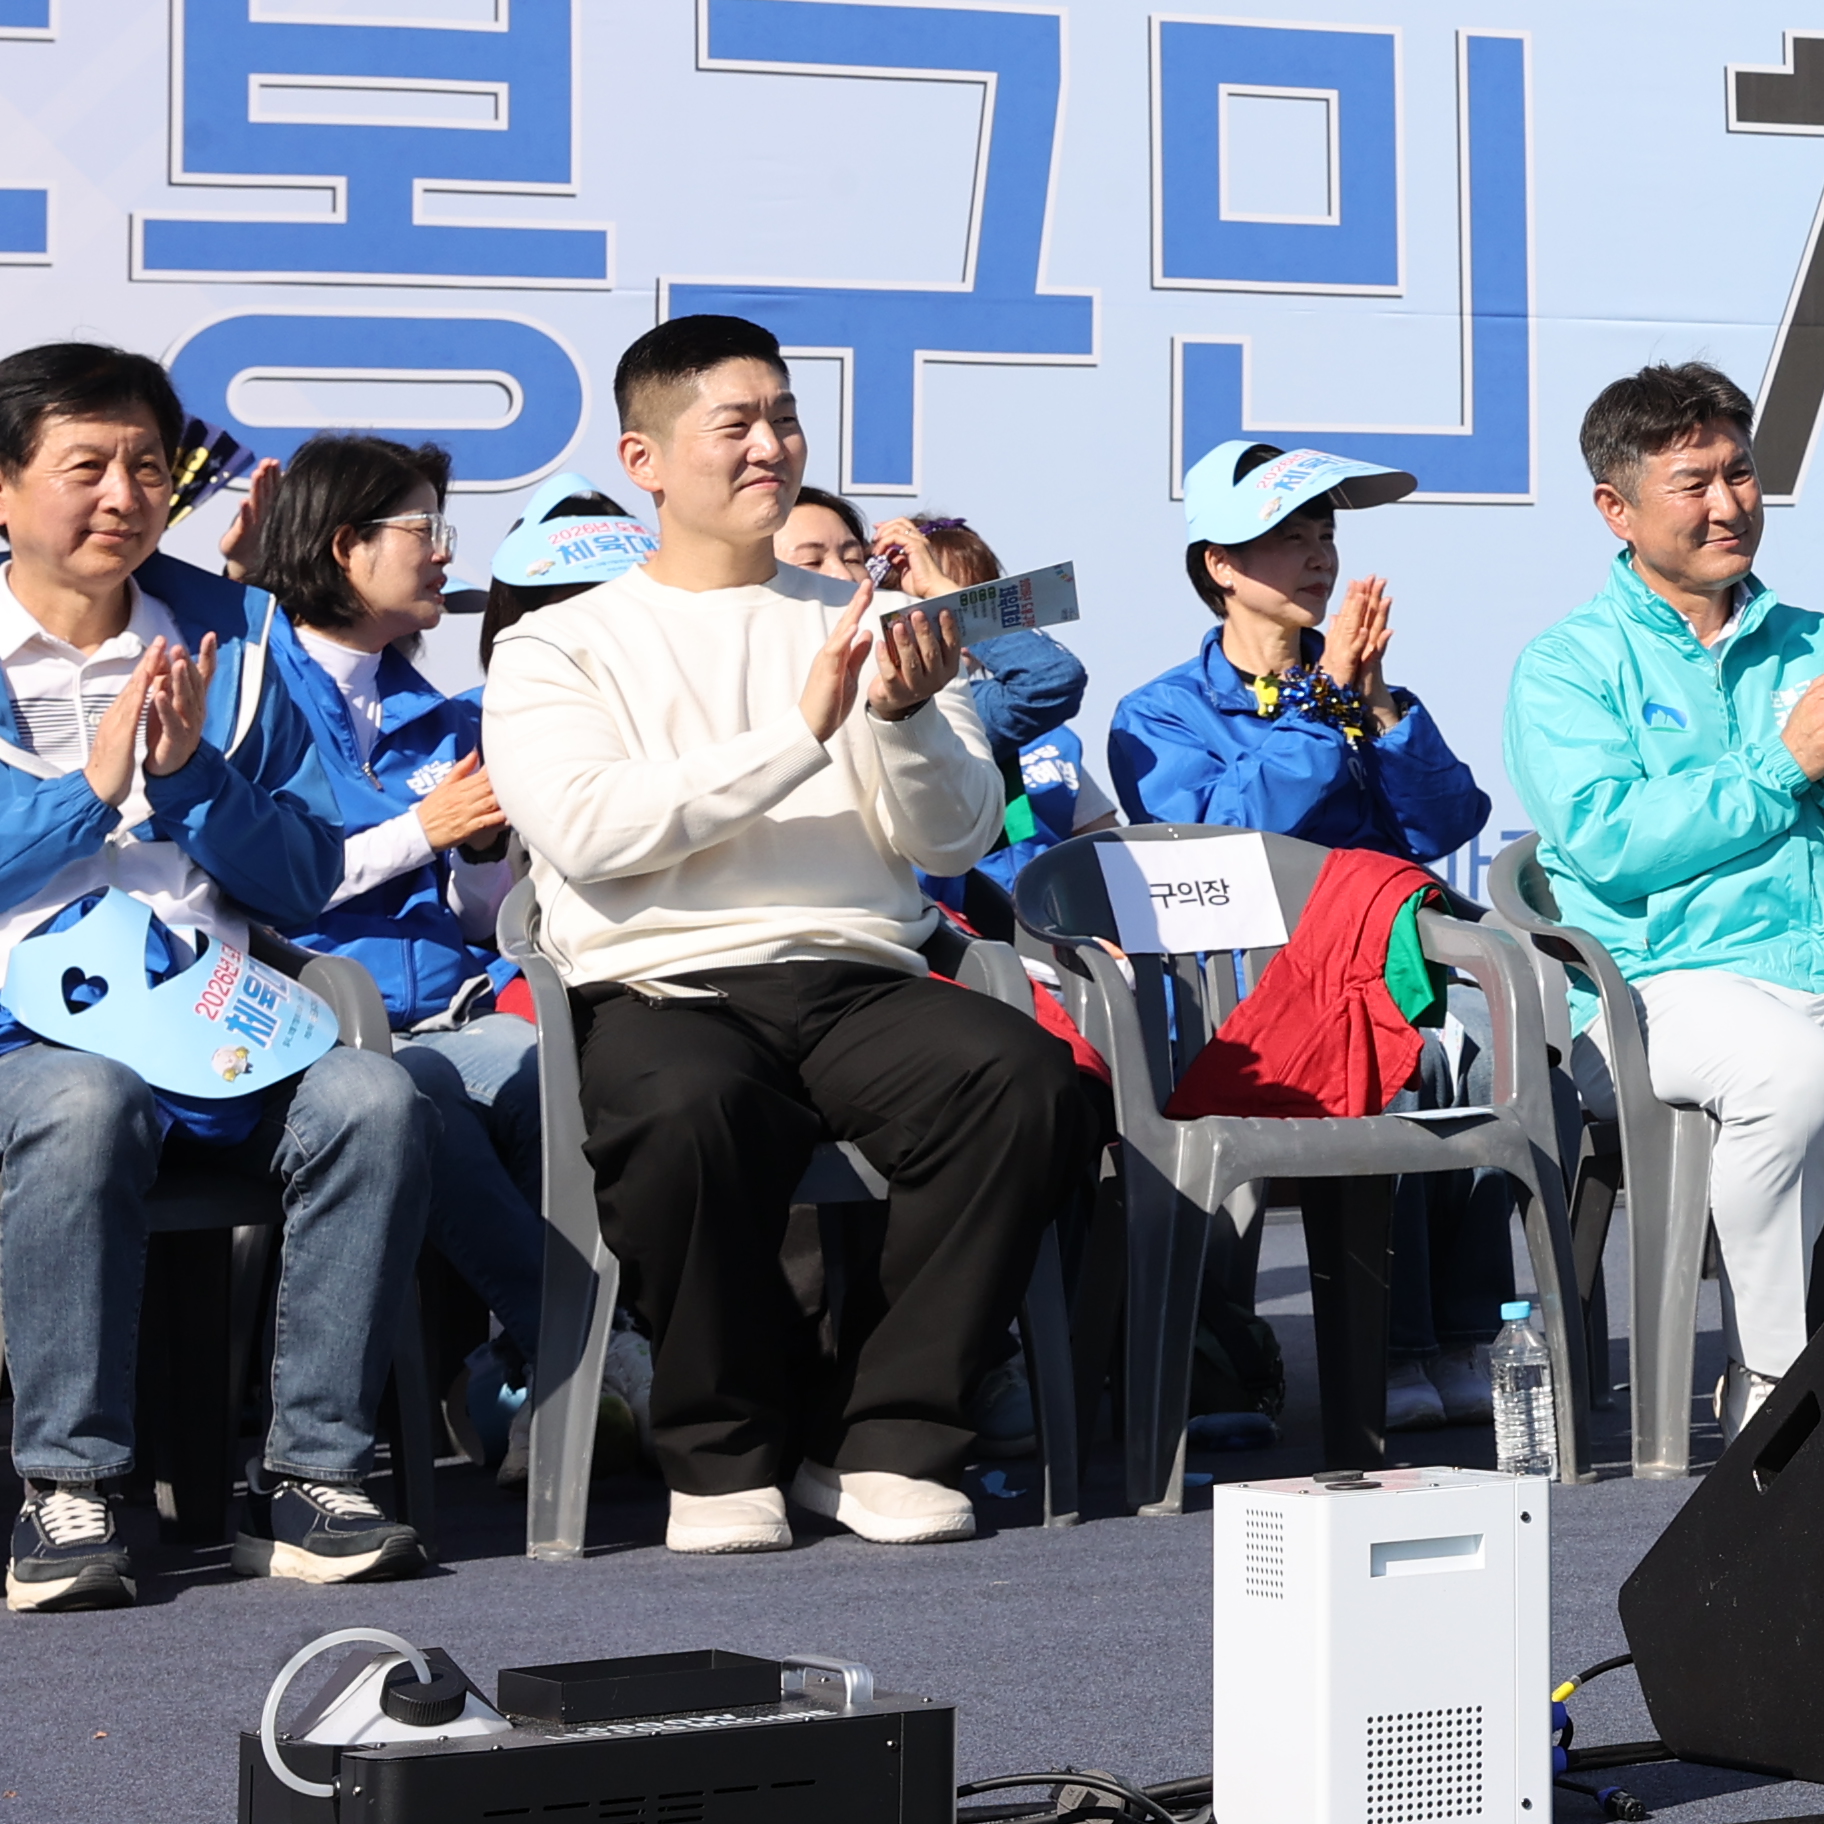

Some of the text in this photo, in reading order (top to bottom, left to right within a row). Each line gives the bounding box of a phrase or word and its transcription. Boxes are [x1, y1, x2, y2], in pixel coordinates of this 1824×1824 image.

[548, 521, 612, 546] 2026년
[555, 534, 659, 566] 체육대
[998, 584, 1021, 629] 체육대회
[1149, 878, 1230, 909] 구의장
[195, 956, 243, 1022] 2026년
